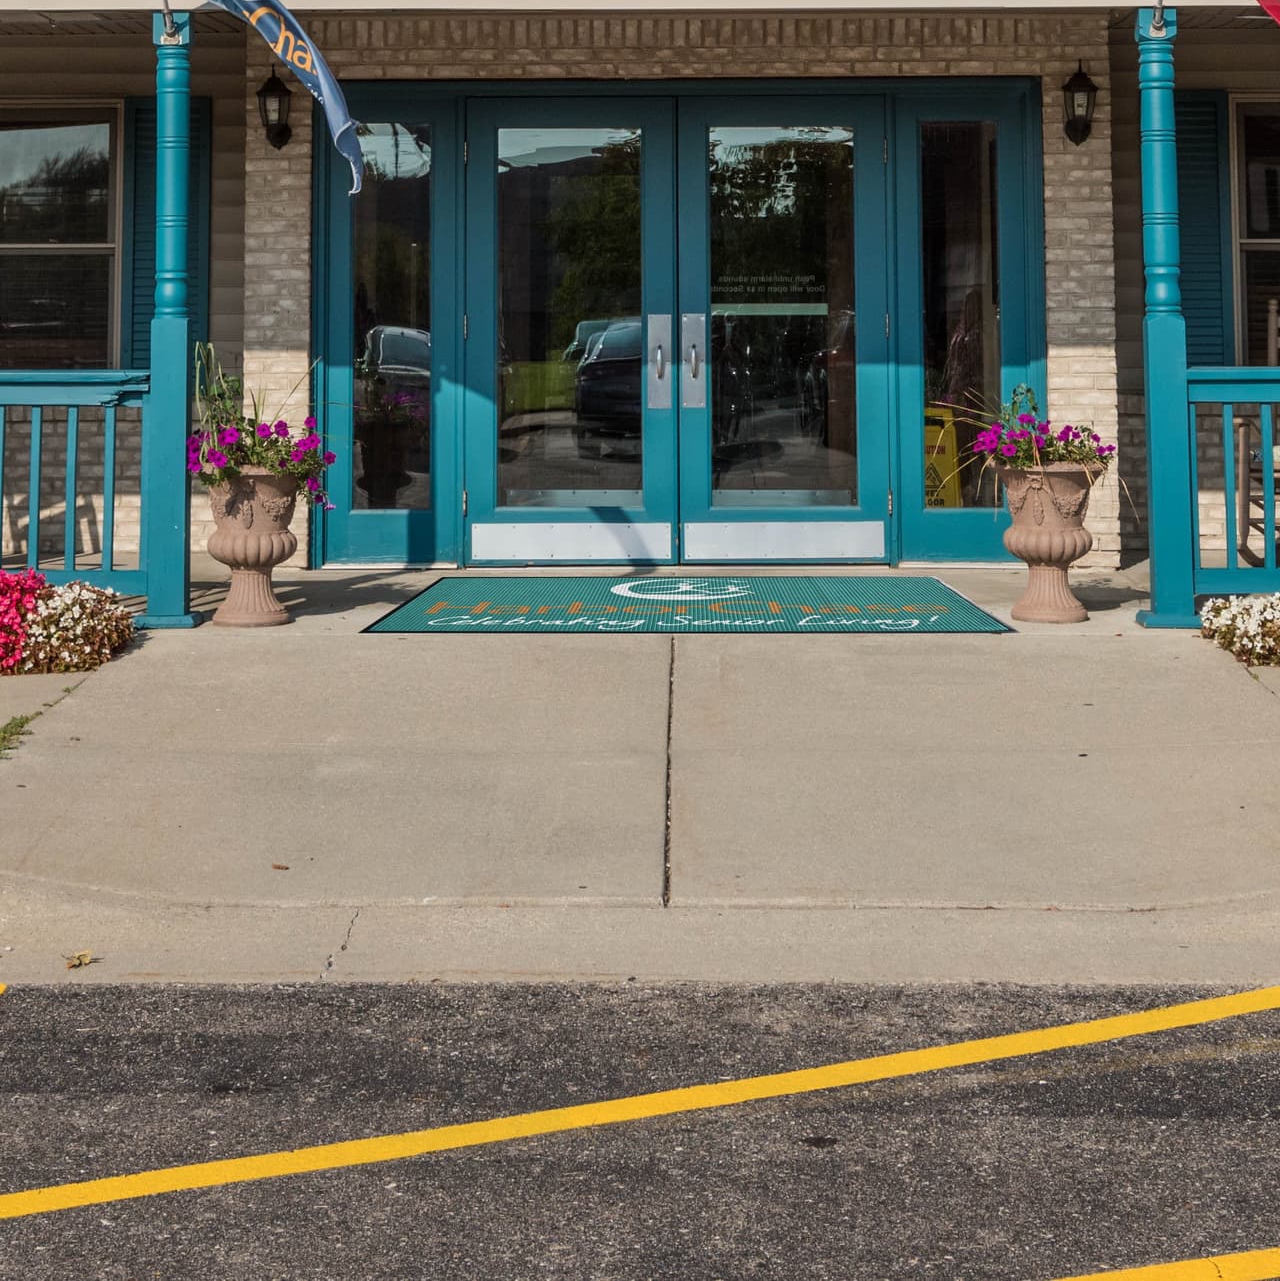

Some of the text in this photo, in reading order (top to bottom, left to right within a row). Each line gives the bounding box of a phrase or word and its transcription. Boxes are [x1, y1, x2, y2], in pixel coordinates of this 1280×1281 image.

[424, 600, 948, 616] HarborChase
[427, 615, 645, 630] Celebrating
[657, 615, 784, 626] Senior
